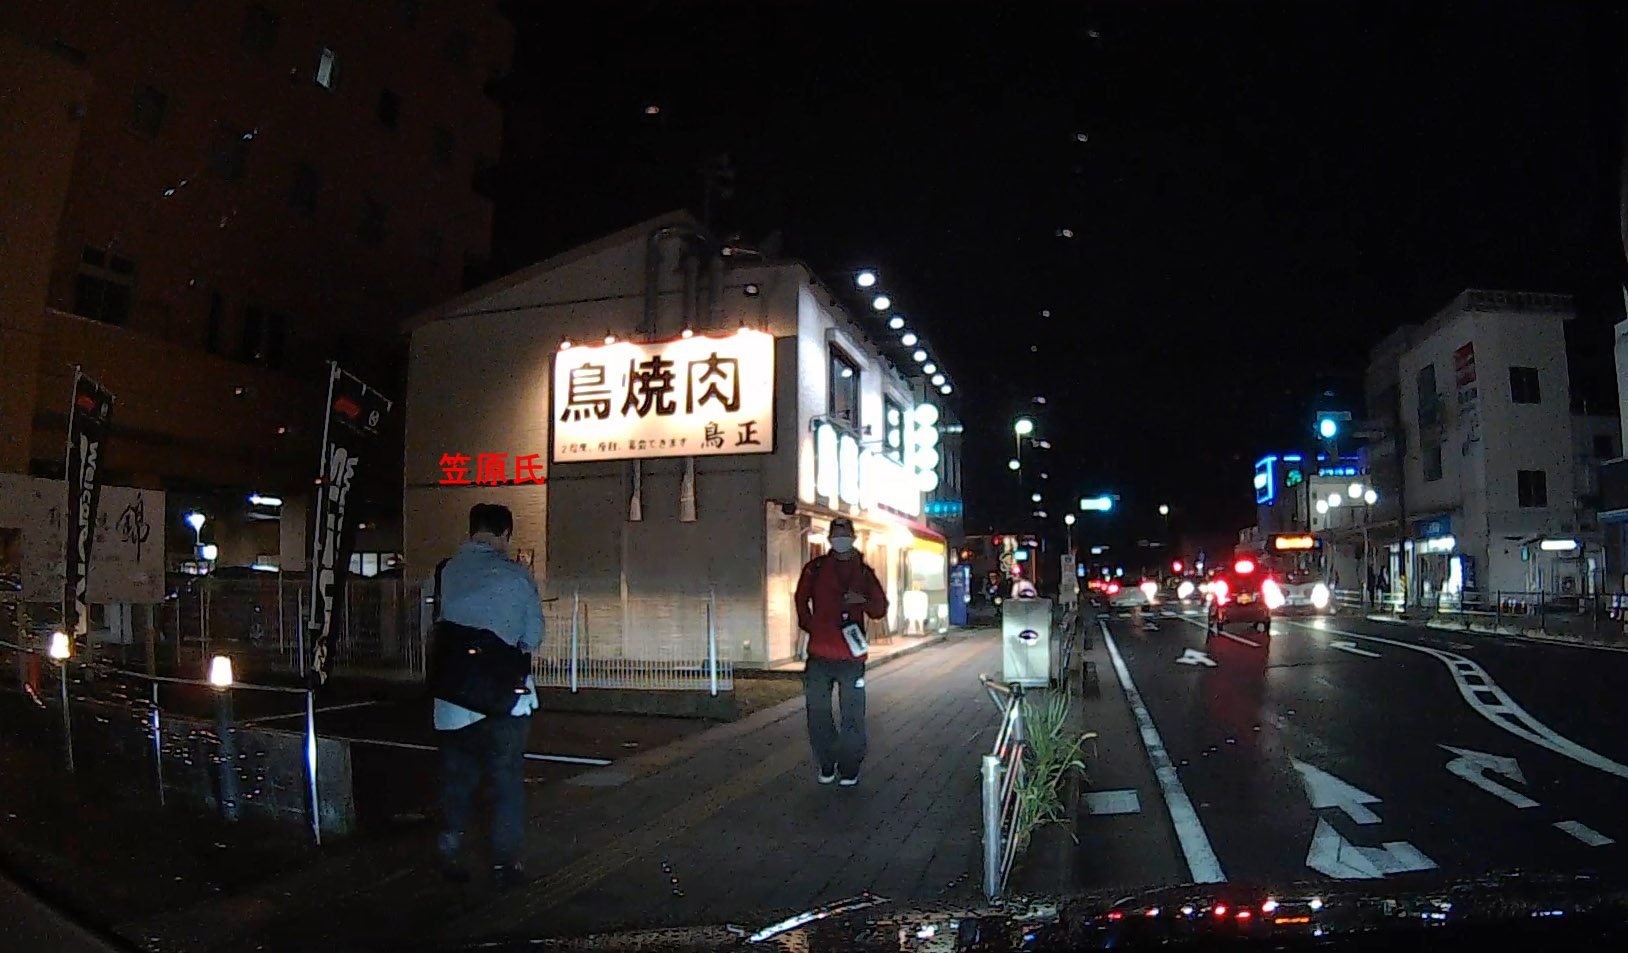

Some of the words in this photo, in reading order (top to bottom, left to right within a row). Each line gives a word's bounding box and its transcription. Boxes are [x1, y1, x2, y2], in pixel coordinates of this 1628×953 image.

[560, 351, 742, 422] 鳥焼肉
[700, 420, 762, 449] 鳥正
